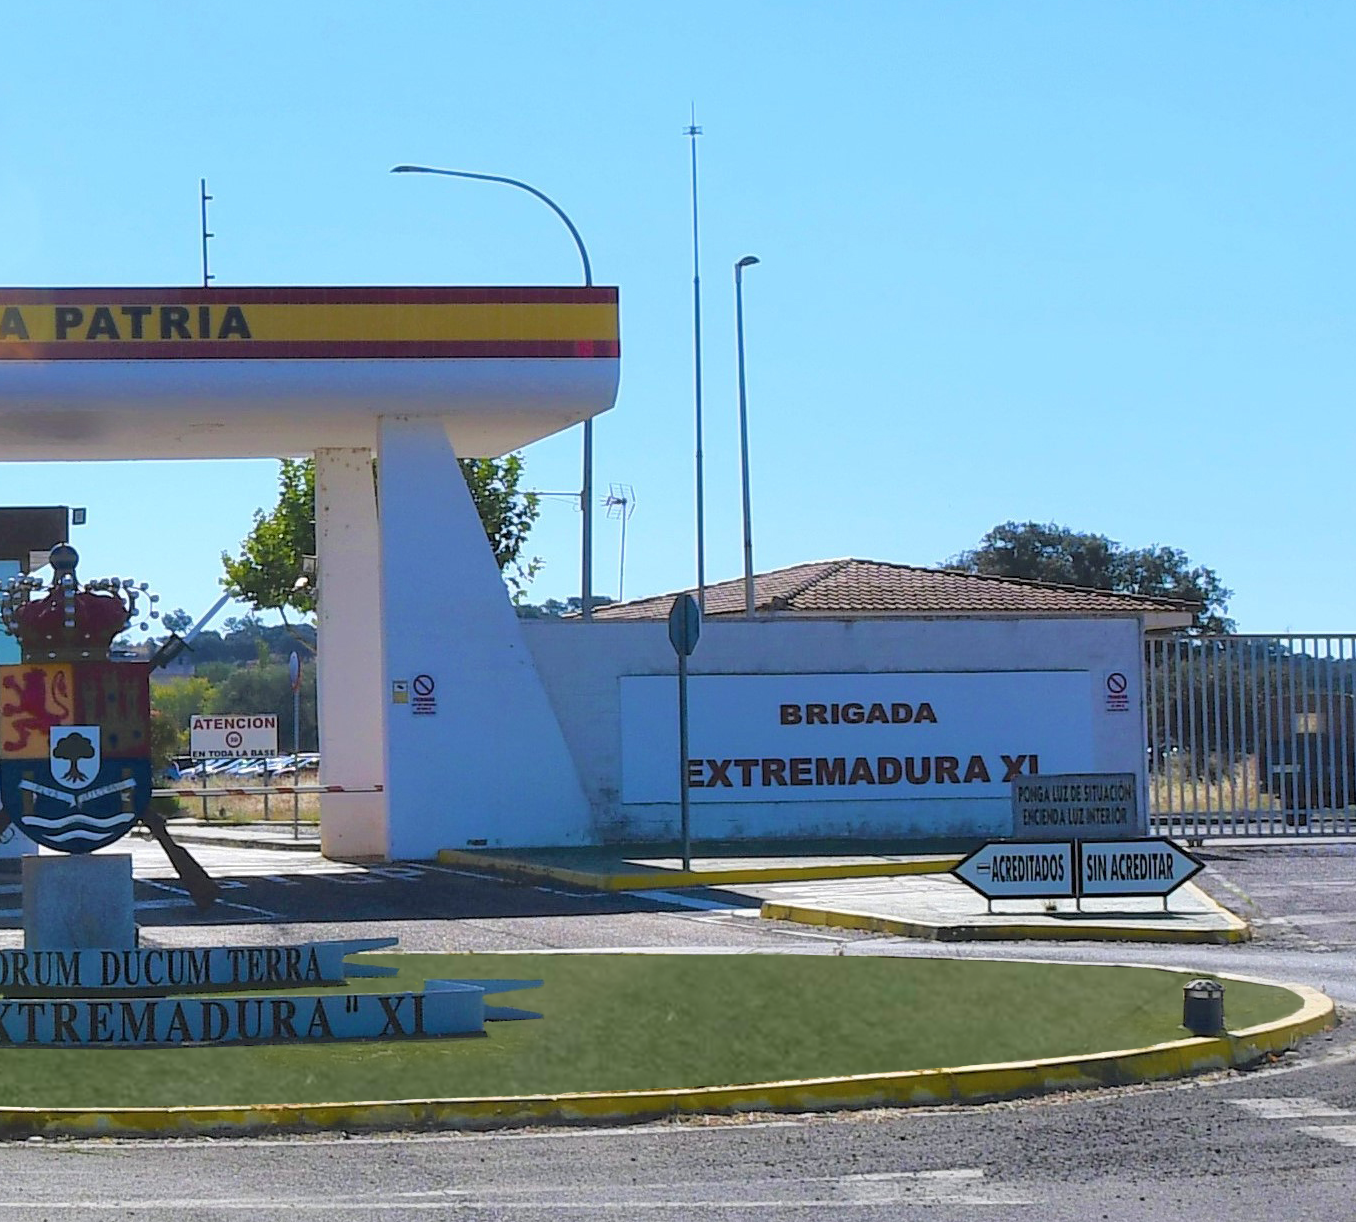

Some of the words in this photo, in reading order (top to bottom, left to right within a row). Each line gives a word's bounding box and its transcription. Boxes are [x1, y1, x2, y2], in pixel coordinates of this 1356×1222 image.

[54, 304, 253, 341] PATRIA
[193, 717, 276, 730] ATENCION
[779, 702, 938, 725] BRIGADA
[192, 750, 206, 758] EN
[236, 749, 248, 757] LA
[250, 749, 275, 757] BASE
[687, 754, 992, 788] EXTREMADURA
[1000, 754, 1039, 784] XI
[1017, 785, 1050, 803] PONGA
[1052, 784, 1068, 802] LUZ
[1070, 784, 1081, 802] DE
[1084, 780, 1132, 802] SITUACIÓN
[1023, 807, 1065, 826] ENCIENDA
[1068, 807, 1084, 826] LUZ
[1087, 806, 1127, 825] INTERIOR
[991, 854, 1064, 883] ACREDITADOS
[1087, 854, 1107, 882] SIN
[1110, 853, 1174, 881] ACREDITAR
[100, 948, 211, 986] DUCUM
[226, 946, 323, 983] TERRA
[377, 995, 427, 1037] XI
